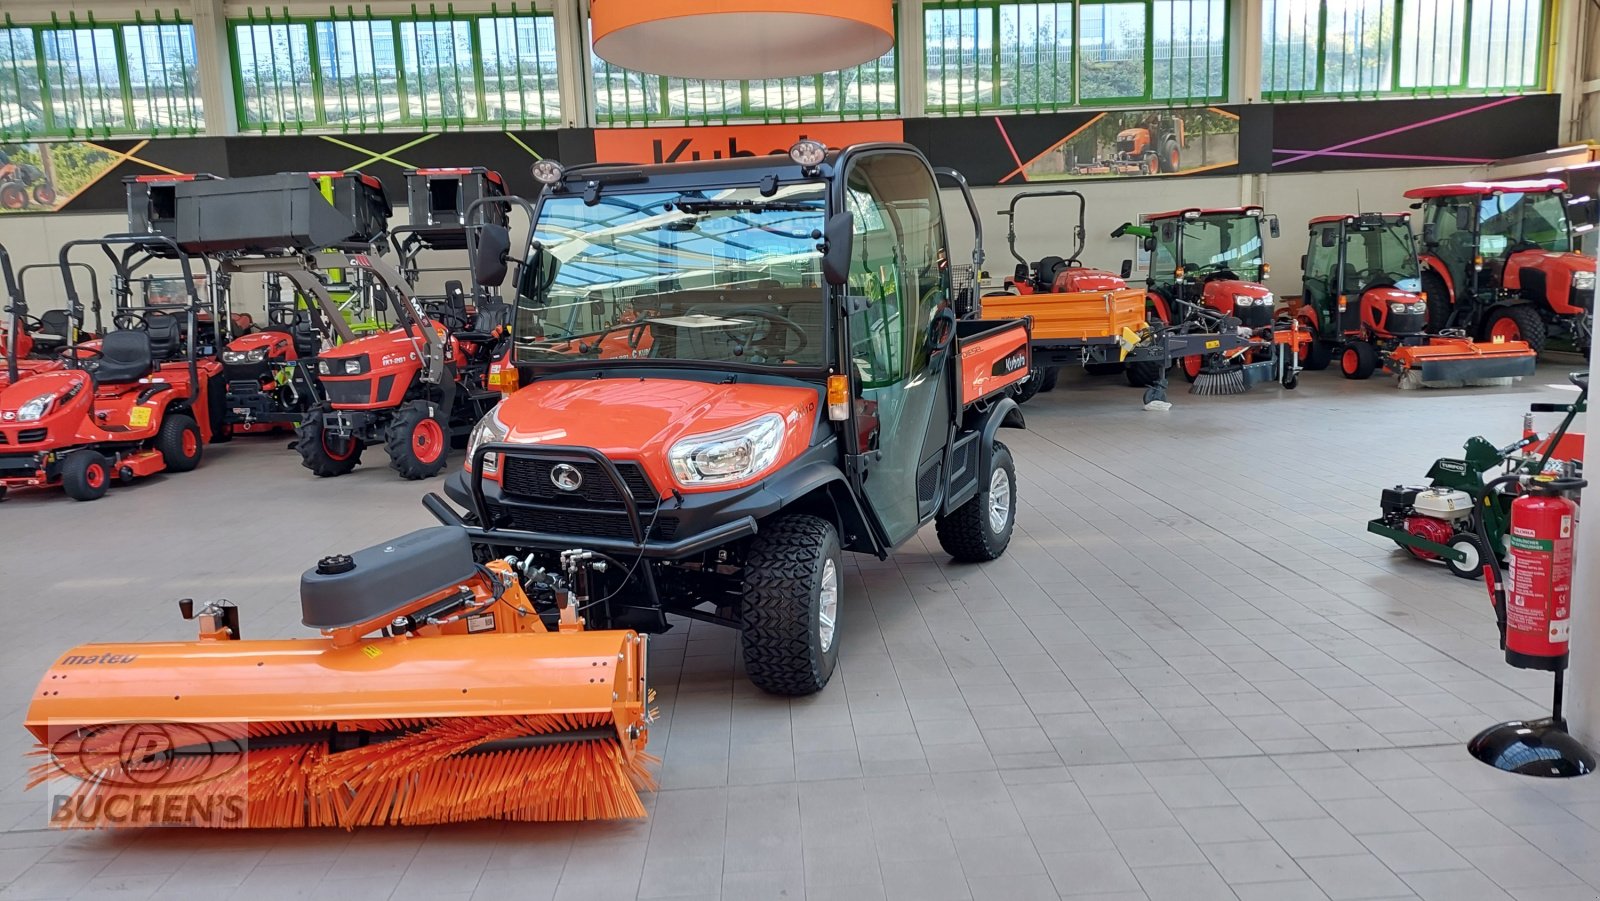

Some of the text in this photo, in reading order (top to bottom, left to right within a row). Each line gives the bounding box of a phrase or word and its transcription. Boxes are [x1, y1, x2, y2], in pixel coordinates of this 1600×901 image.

[962, 346, 984, 358] DIESEL
[1005, 353, 1025, 371] Kubota
[61, 653, 137, 665] matev
